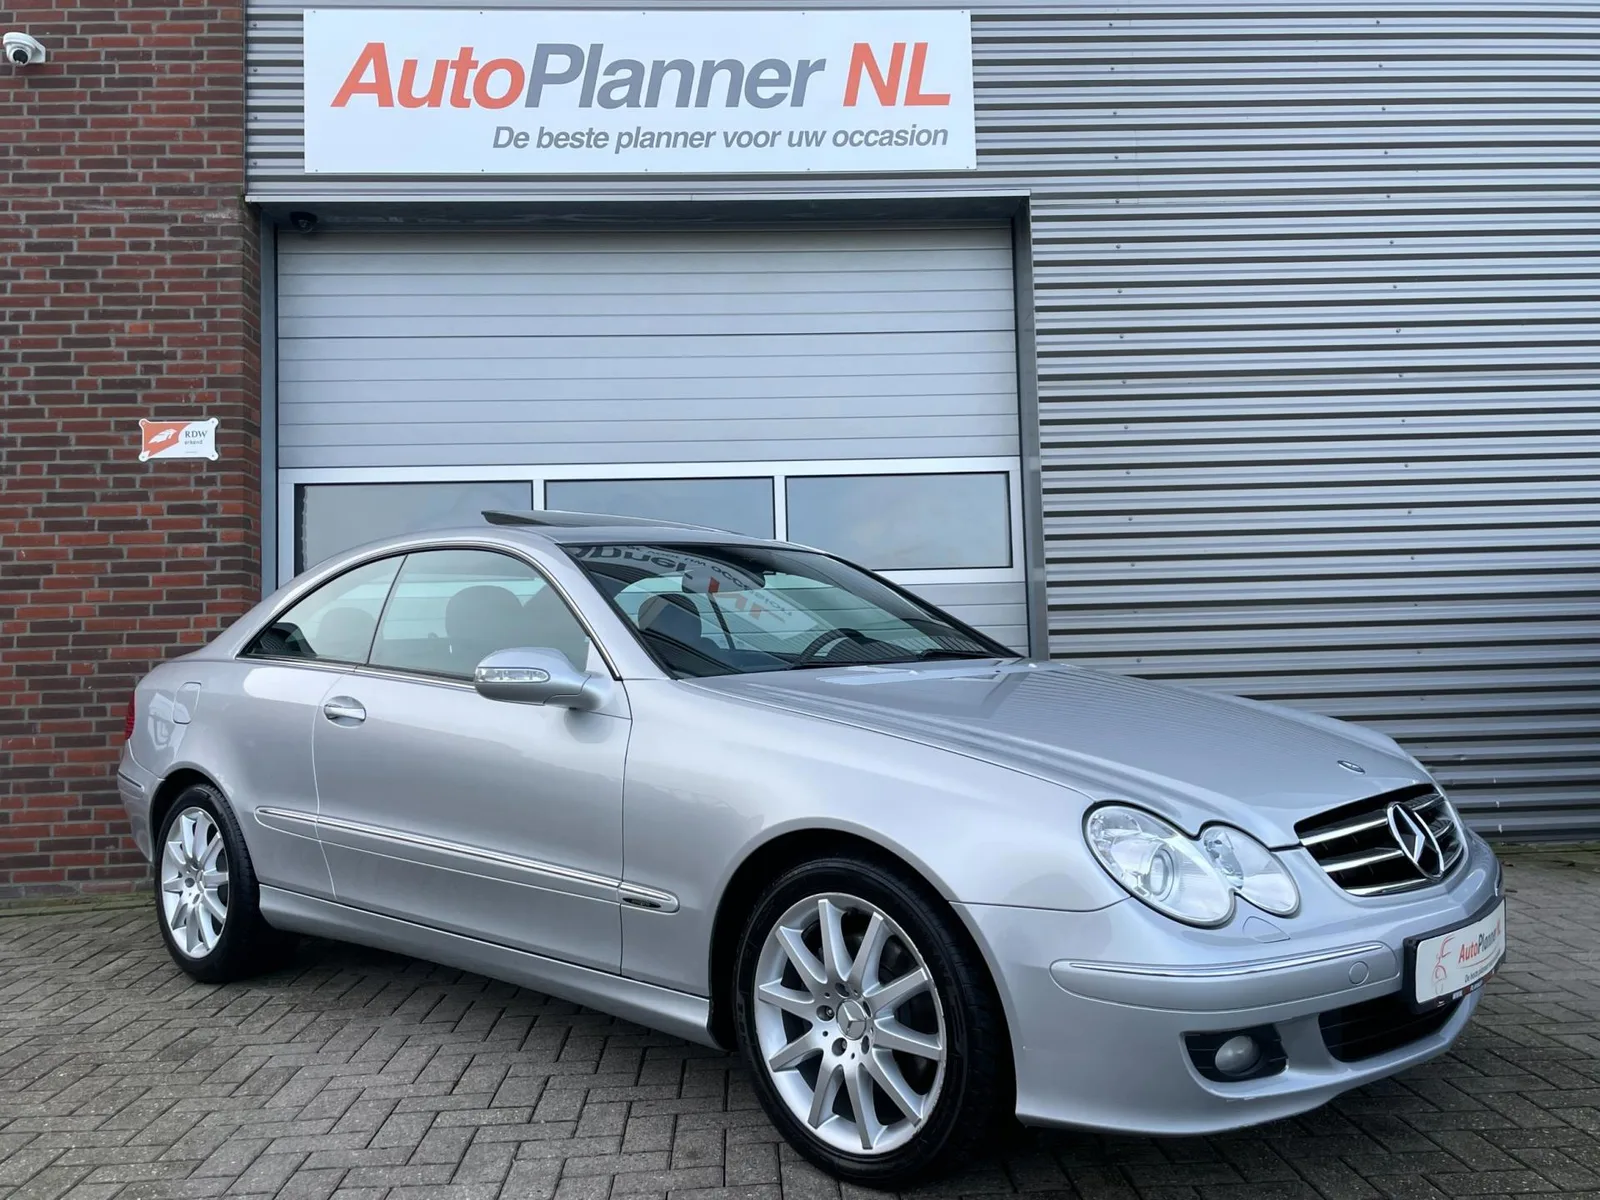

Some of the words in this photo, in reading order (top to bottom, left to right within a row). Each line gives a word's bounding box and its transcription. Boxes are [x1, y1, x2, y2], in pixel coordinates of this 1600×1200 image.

[330, 42, 827, 109] AutoPlanner
[843, 42, 951, 107] NL
[493, 126, 530, 149] De
[536, 126, 609, 149] beste
[615, 126, 716, 154] planner
[723, 130, 783, 149] voor
[788, 130, 827, 148] uw
[832, 124, 949, 148] occasion
[185, 430, 208, 438] RDW
